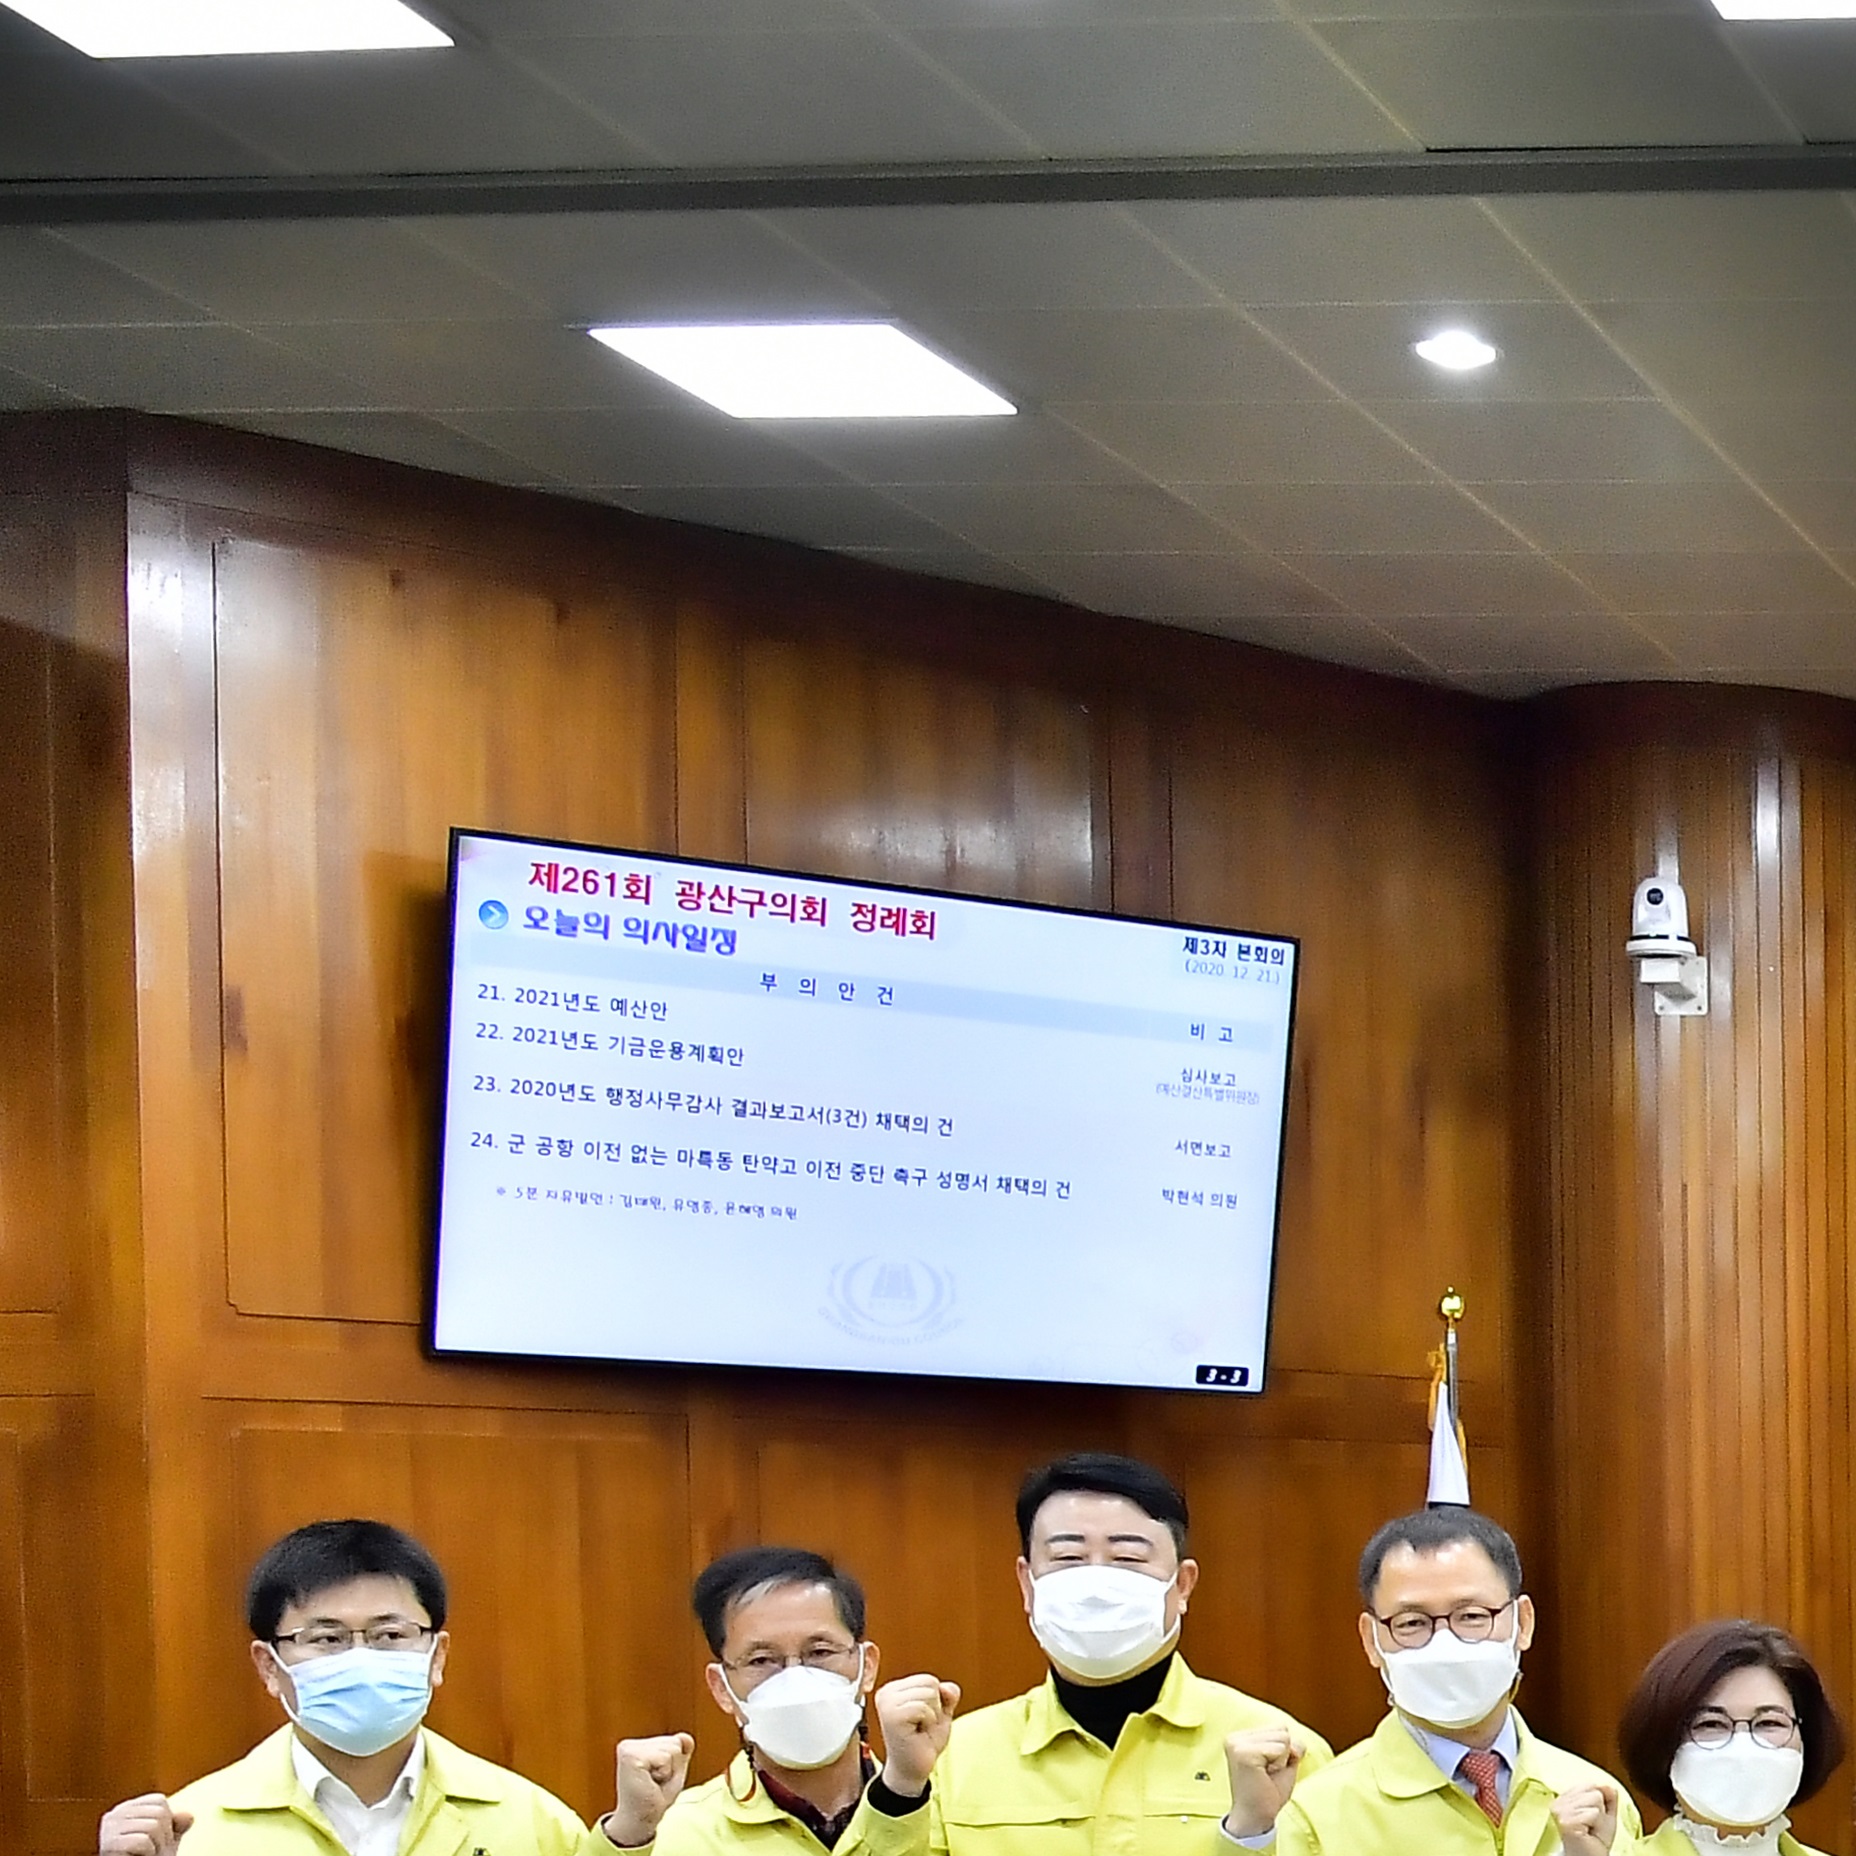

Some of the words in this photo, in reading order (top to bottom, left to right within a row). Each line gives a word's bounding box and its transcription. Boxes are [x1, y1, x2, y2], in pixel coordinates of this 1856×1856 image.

[529, 862, 651, 905] 제261회
[675, 880, 827, 927] 광산구의회
[850, 903, 935, 940] 정례회
[523, 906, 610, 940] 오늘의
[623, 917, 736, 956] 의사일정
[478, 984, 505, 1001] 21.
[515, 988, 600, 1012] 2021년도
[610, 998, 667, 1021] 예산안
[760, 973, 777, 992] 부
[839, 983, 855, 1001] 안
[877, 986, 893, 1006] 건
[476, 1023, 503, 1039] 22.
[513, 1027, 598, 1050] 2021년도
[609, 1036, 743, 1067] 기금운용계획안
[1191, 1023, 1205, 1040] 비
[1218, 1027, 1233, 1042] 고
[1181, 1068, 1236, 1087] 심사보고
[474, 1075, 501, 1092] 23.
[510, 1079, 596, 1102] 2020년도
[606, 1087, 722, 1115] 행정사무감사
[732, 1099, 867, 1128] 결과보고서(3건)
[876, 1112, 928, 1134] 채택의
[938, 1118, 952, 1137] 건
[471, 1132, 498, 1148] 24.
[508, 1134, 525, 1154] 군
[535, 1136, 573, 1158] 공항
[584, 1141, 621, 1162] 이전
[631, 1145, 668, 1166] 없는
[743, 1155, 797, 1175] 탄약고
[806, 1160, 841, 1180] 이전
[850, 1163, 884, 1184] 중단
[936, 1171, 987, 1192] 성명서
[996, 1176, 1046, 1197] 채택의
[1056, 1181, 1070, 1199] 건
[1162, 1189, 1203, 1206] 박현석
[1210, 1193, 1237, 1209] 의원
